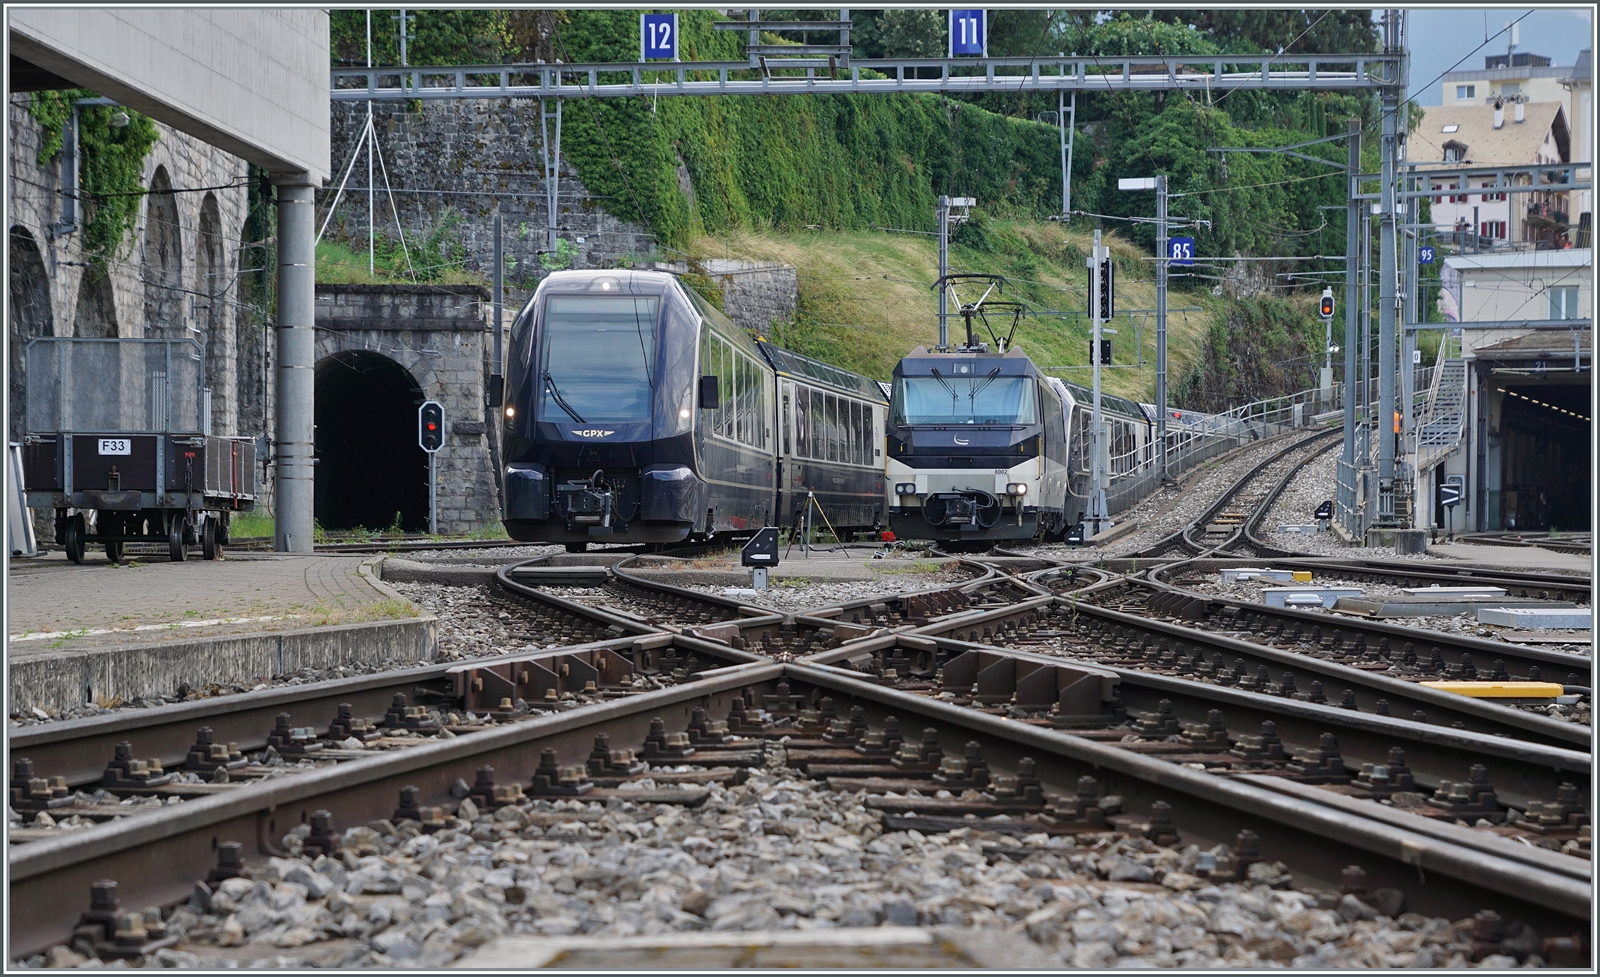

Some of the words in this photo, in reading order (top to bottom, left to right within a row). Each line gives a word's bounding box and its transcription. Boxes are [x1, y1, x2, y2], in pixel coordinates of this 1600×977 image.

[648, 22, 671, 49] 12
[959, 18, 977, 45] 11
[1173, 242, 1191, 260] 85
[1421, 249, 1432, 261] 95
[1535, 360, 1546, 372] 21
[582, 429, 604, 438] GPX
[102, 440, 125, 451] F33
